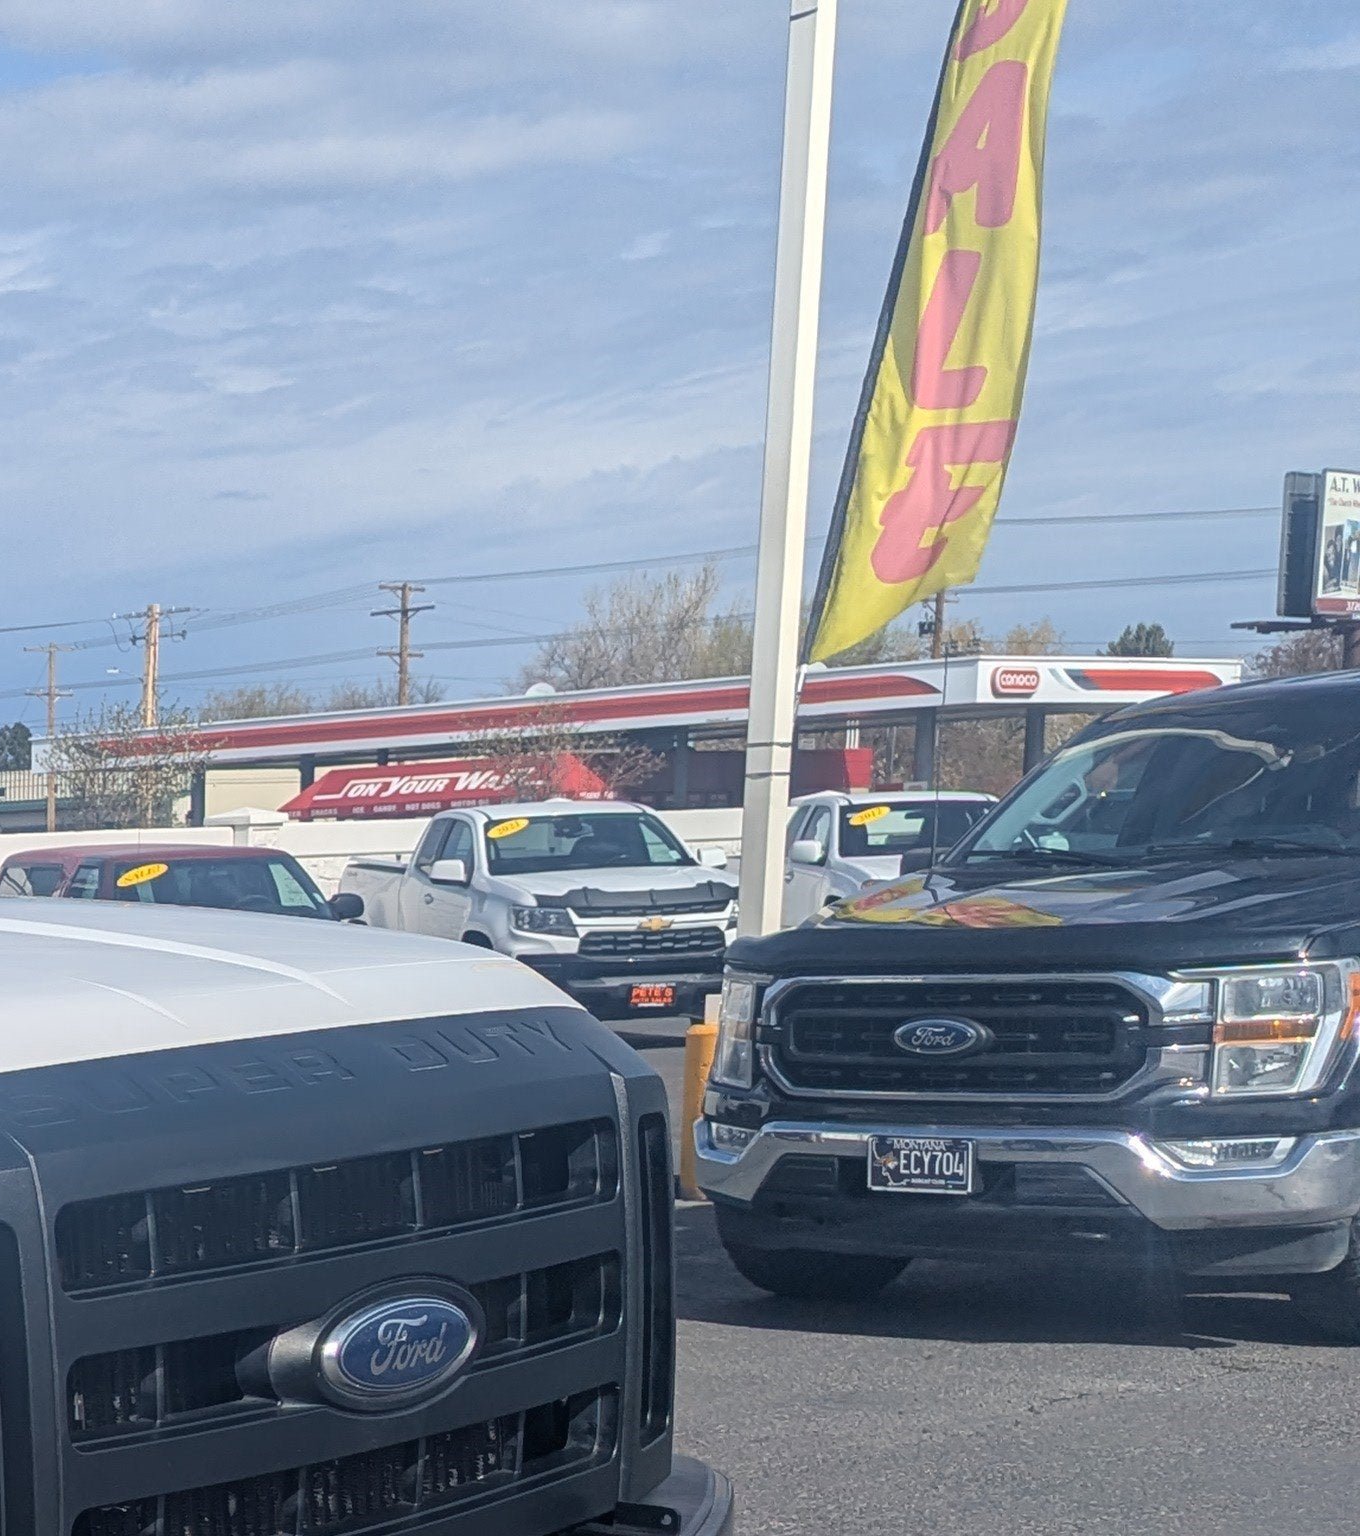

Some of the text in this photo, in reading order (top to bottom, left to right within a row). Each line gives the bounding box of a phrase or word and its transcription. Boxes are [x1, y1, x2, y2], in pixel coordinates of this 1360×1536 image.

[347, 783, 382, 797] ON
[388, 1020, 574, 1073] DUTY
[911, 1026, 954, 1046] Ford
[893, 1138, 947, 1151] MONTANA
[899, 1150, 964, 1177] ECY704
[370, 1315, 448, 1377] Ford
